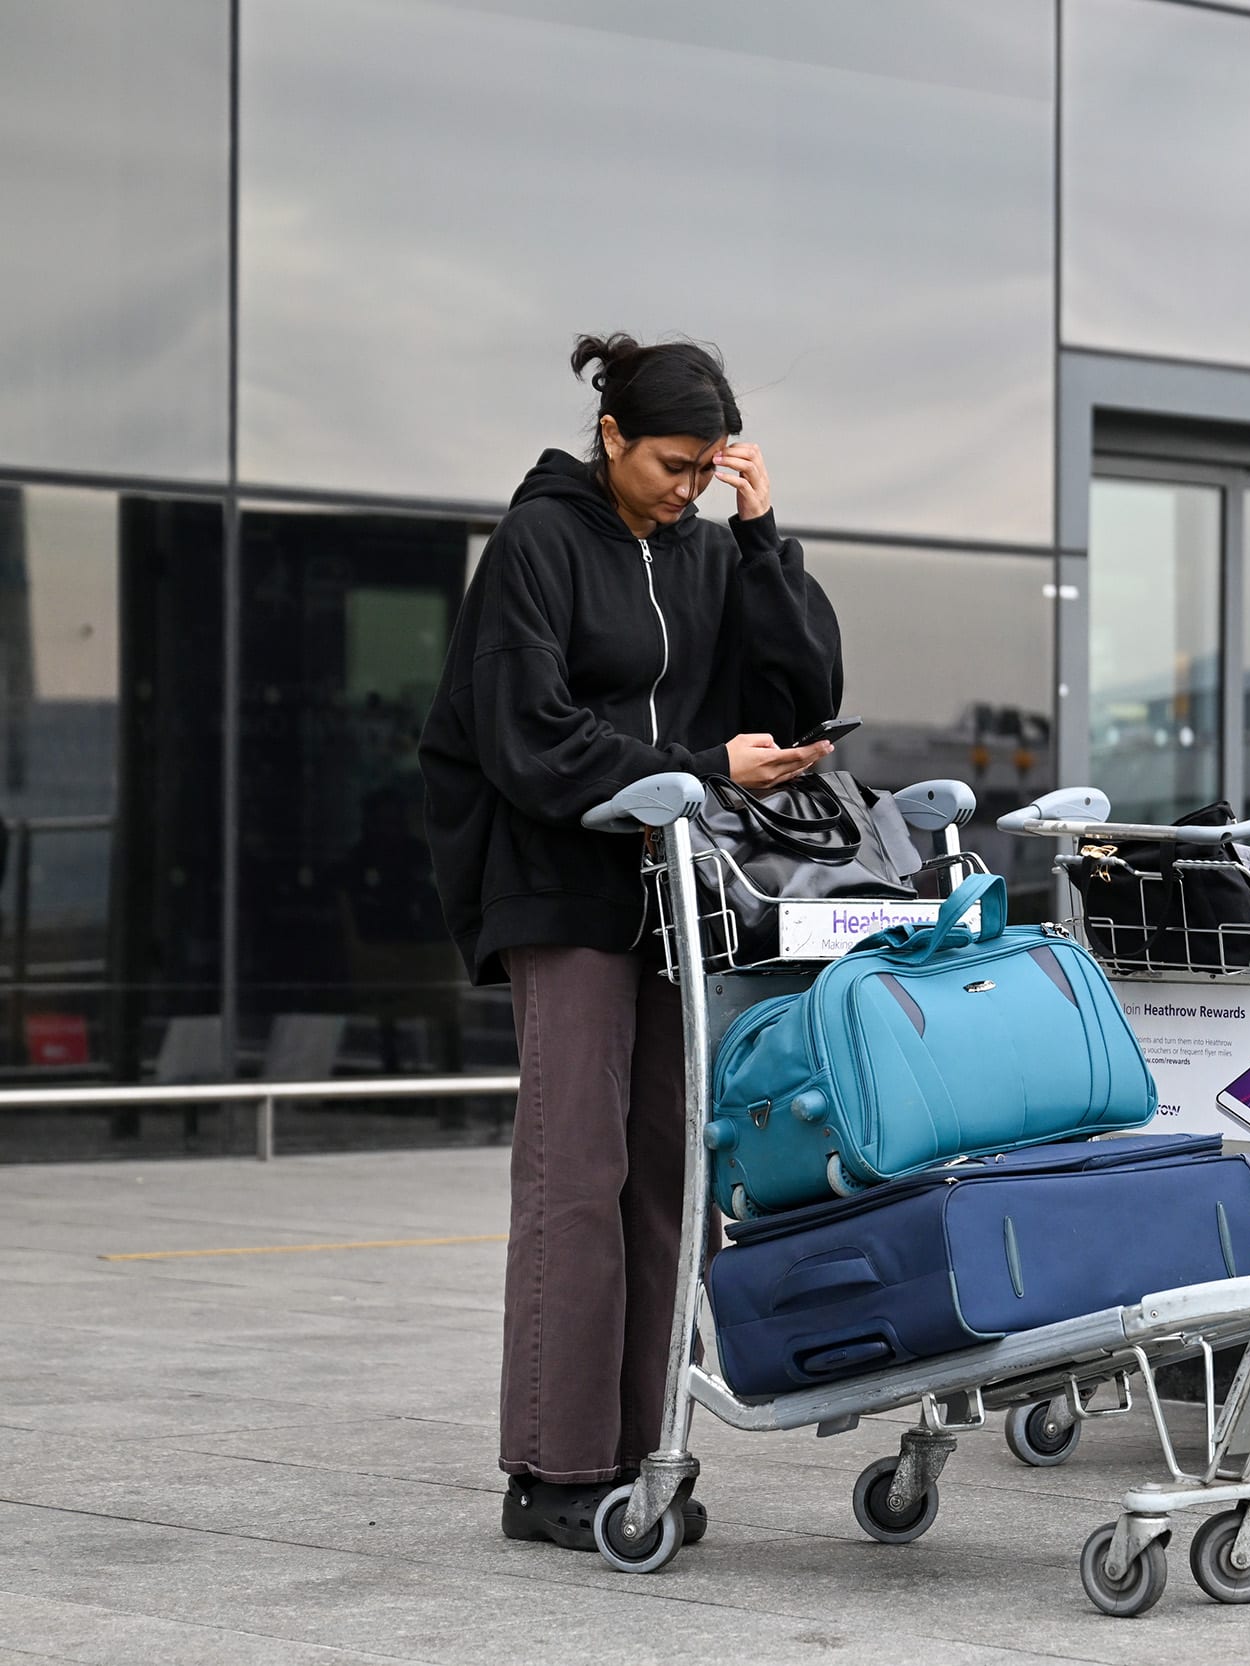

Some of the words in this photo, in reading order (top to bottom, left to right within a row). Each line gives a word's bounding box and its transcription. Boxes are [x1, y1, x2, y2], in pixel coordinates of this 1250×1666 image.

[822, 938, 854, 952] Making
[1122, 1002, 1141, 1016] Join
[1144, 1003, 1198, 1018] Heathrow
[1199, 1005, 1246, 1019] Rewards
[1153, 1036, 1164, 1044] and
[1177, 1037, 1192, 1045] them
[1205, 1038, 1232, 1047] Heathrow
[1147, 1047, 1172, 1055] vouchers
[1179, 1047, 1204, 1057] frequent
[1204, 1048, 1217, 1058] flyer
[1217, 1049, 1232, 1057] miles
[1145, 1057, 1191, 1066] w.com/rewards
